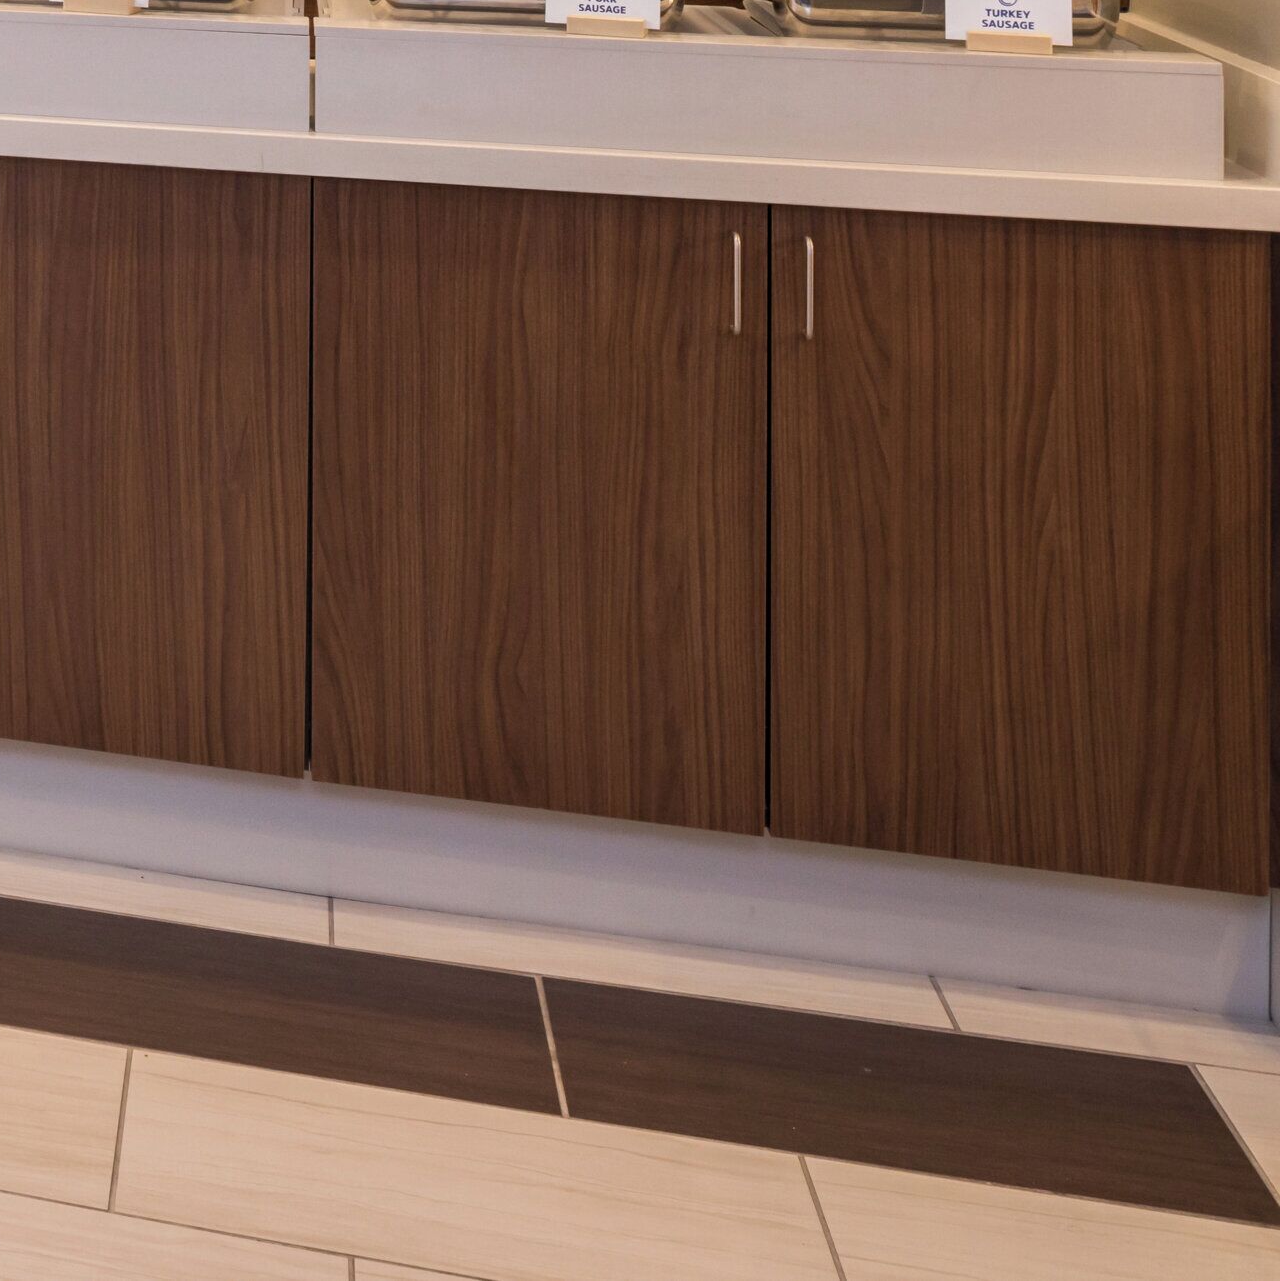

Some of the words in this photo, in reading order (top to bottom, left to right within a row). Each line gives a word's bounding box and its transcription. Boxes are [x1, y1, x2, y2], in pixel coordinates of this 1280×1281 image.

[578, 3, 626, 14] SAUSAGE
[985, 8, 1031, 18] TURKEY
[982, 19, 1035, 30] SAUSAGE
